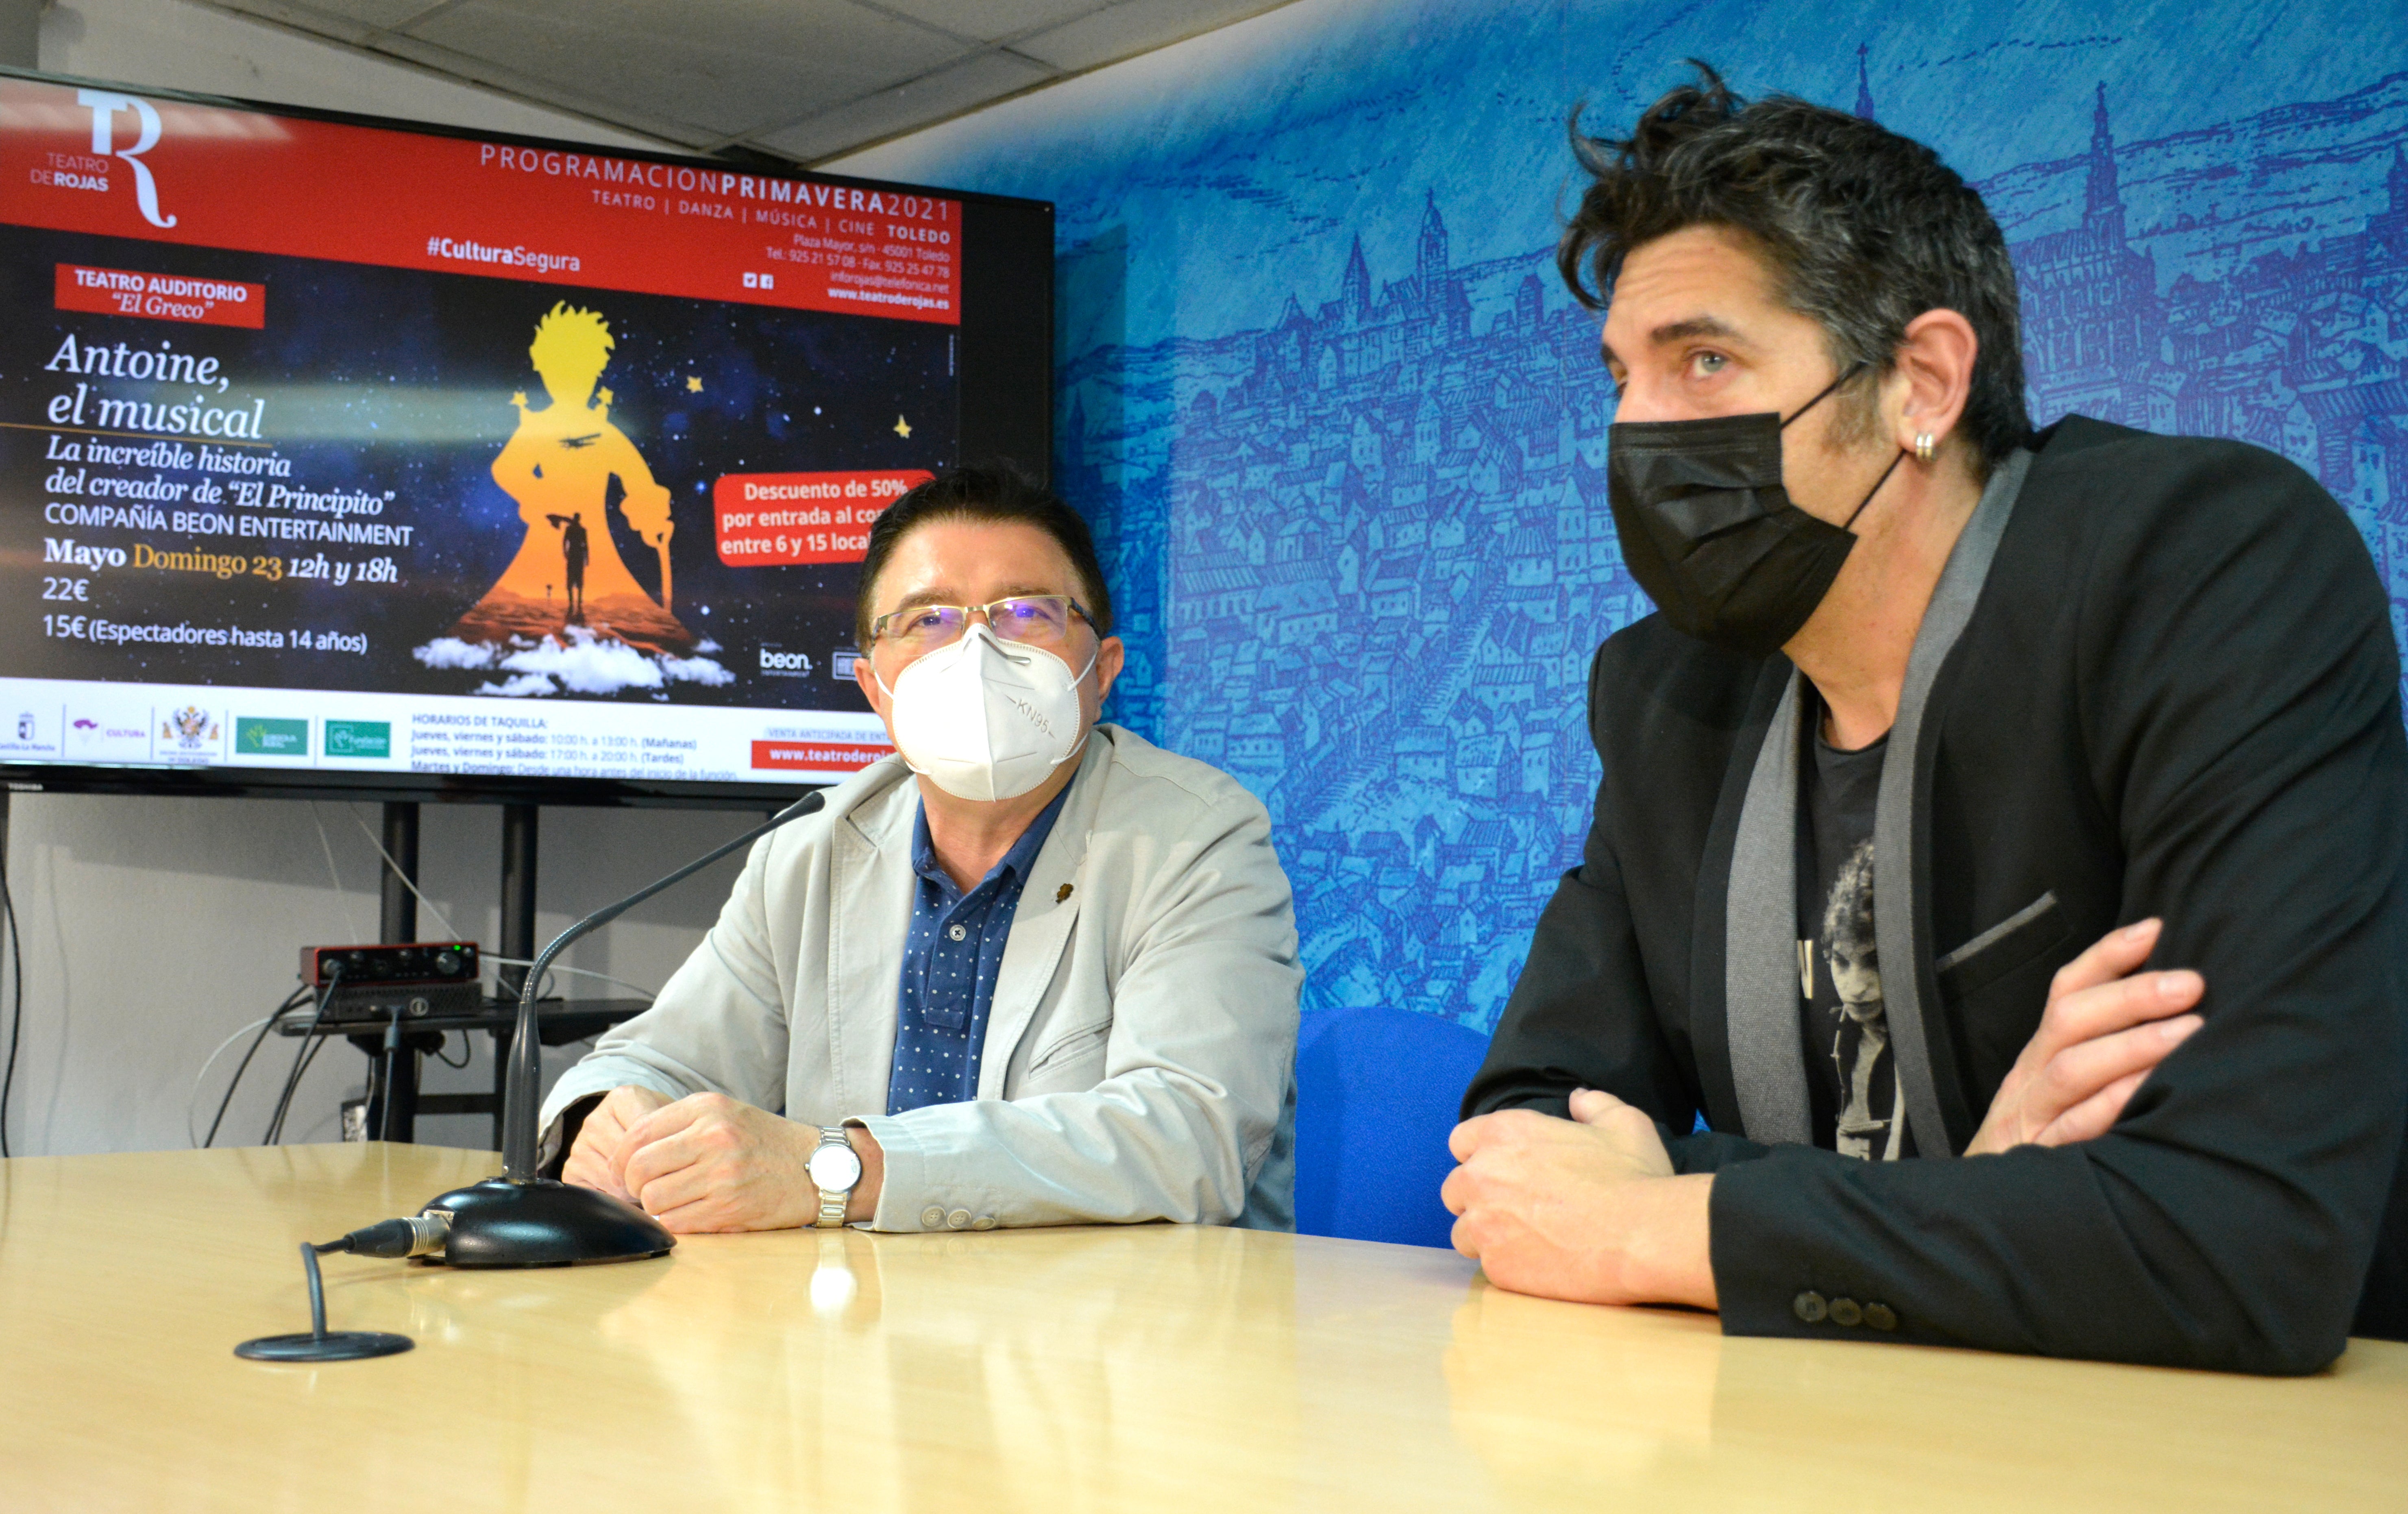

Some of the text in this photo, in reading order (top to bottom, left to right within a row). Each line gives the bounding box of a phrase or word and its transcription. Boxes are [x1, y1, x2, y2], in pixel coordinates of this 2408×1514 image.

[46, 152, 109, 174] TEATRO
[592, 190, 950, 244] TEATRO DANZA MÚSICA CINE TOLEDO
[427, 236, 580, 273] #CulturaSegura
[794, 233, 821, 248] Plaza
[915, 247, 951, 263] Toledo
[788, 249, 810, 264] 925
[811, 251, 823, 264] 21
[826, 253, 840, 266] 57
[884, 259, 905, 274] 925
[906, 262, 920, 276] 25
[921, 264, 935, 277] 47
[937, 266, 950, 279] 78
[75, 269, 247, 302] TEATRO AUDITORIO
[827, 288, 949, 310] www.teatroderojas.es
[45, 333, 230, 394] Antoine,
[48, 383, 265, 439] el musical
[46, 436, 292, 477] La increíble historia
[45, 467, 85, 495] del
[89, 471, 189, 501] creador
[192, 477, 222, 504] de
[745, 477, 908, 501] Descuento de 50%
[45, 502, 414, 547] COMPAÑÍA BEON ENTERTAINMENT
[723, 505, 886, 532] por entrada al co
[721, 537, 772, 555] entre
[775, 535, 788, 553] 6
[790, 538, 803, 557] y
[806, 533, 827, 551] 15
[44, 538, 398, 586] Mayo Domingo 23 12h y 18h
[42, 577, 89, 602] 22€
[231, 628, 283, 649] hasta
[289, 630, 311, 649] 14
[315, 632, 368, 655] años)
[412, 714, 548, 730] HORARIOS DE TAQUILLA:
[1017, 698, 1050, 734] KN95
[411, 730, 451, 743] Jueves,
[454, 731, 494, 743] viernes
[496, 734, 503, 745] y
[506, 732, 548, 744] sábado:
[592, 737, 598, 746] a
[642, 737, 697, 751] (Mañanas)
[769, 728, 797, 737] VENTA
[800, 730, 853, 740] ANTICIPADA
[856, 732, 865, 740] DE
[410, 745, 450, 758] Jueves,
[453, 746, 494, 758] viernes
[496, 749, 503, 761] y
[506, 747, 548, 760] sábado:
[592, 753, 598, 761] a
[641, 752, 684, 766] (Tardes)
[412, 760, 450, 773] Martes
[454, 764, 460, 774] y
[518, 762, 549, 776] Desde
[552, 766, 572, 777] una
[574, 766, 598, 778] hora
[601, 767, 626, 778] antes
[630, 767, 644, 779] del
[675, 769, 687, 780] de
[690, 767, 697, 780] la
